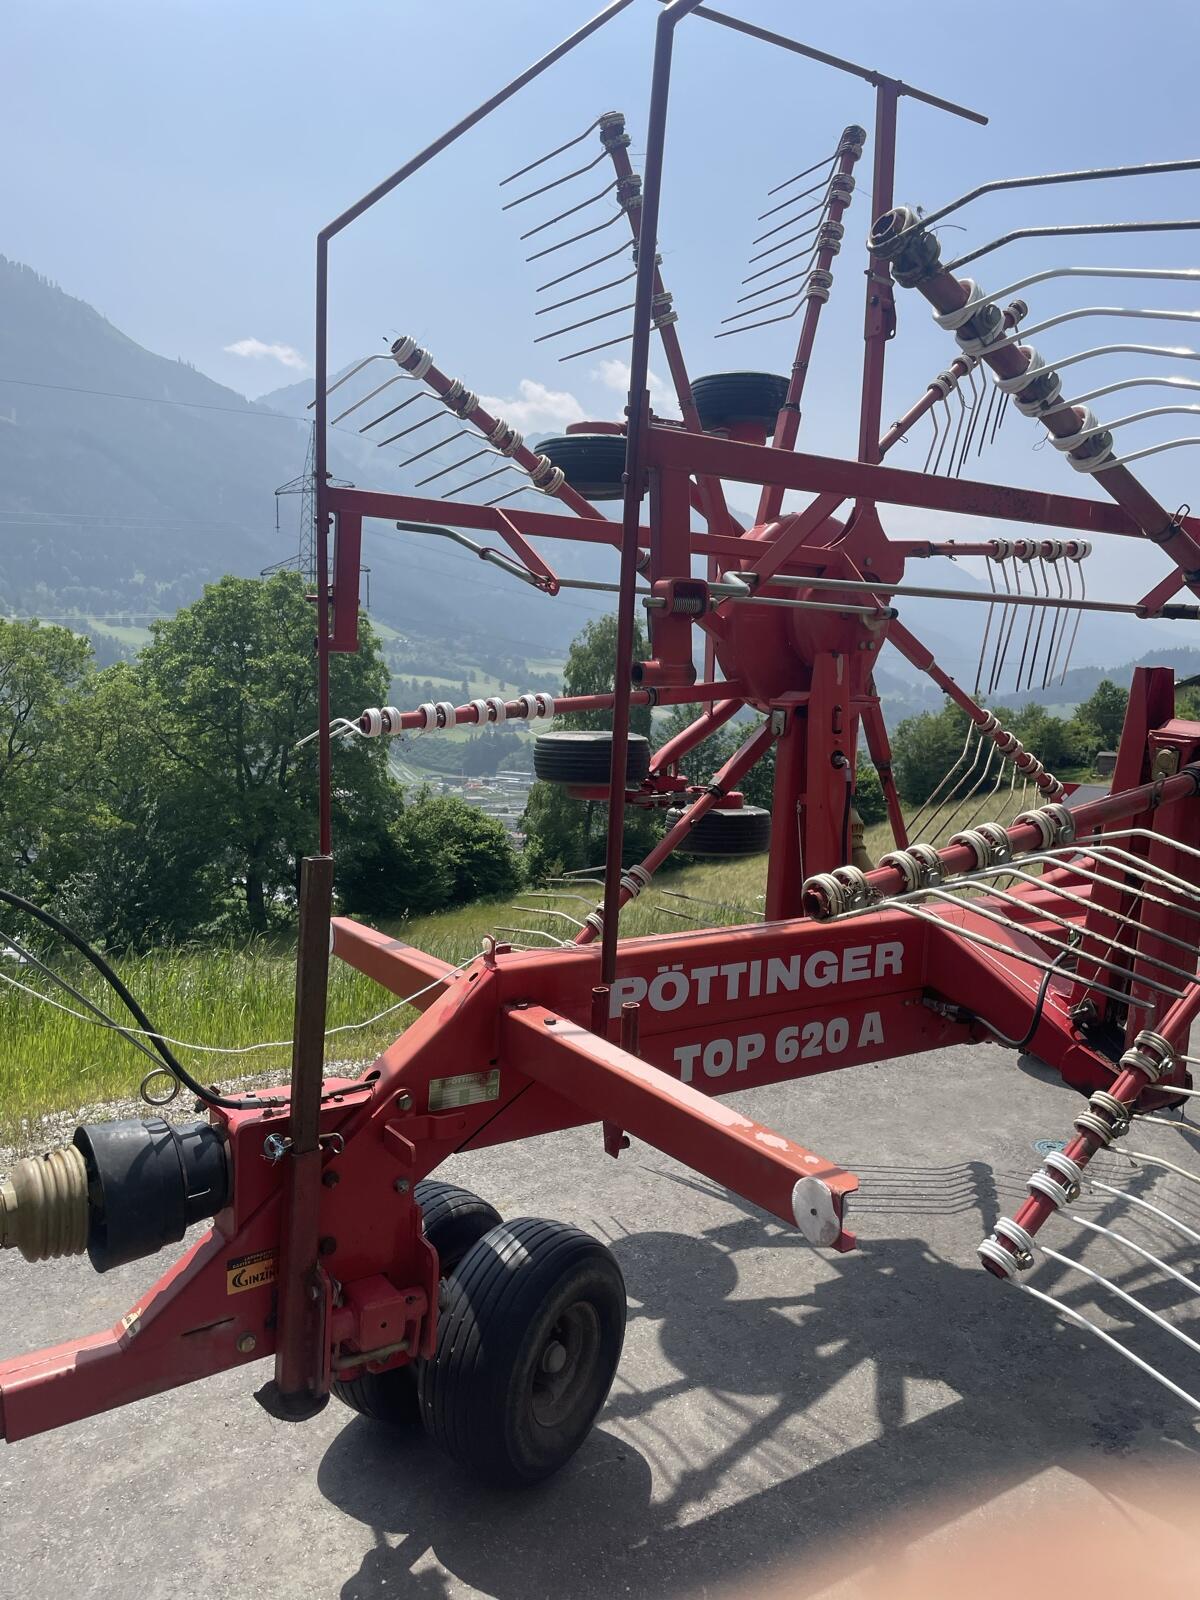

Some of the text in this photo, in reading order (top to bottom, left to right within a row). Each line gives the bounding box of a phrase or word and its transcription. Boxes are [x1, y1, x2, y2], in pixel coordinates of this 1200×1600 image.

[608, 941, 905, 1019] PÖTTINGER
[673, 1011, 885, 1083] TOP 620 A
